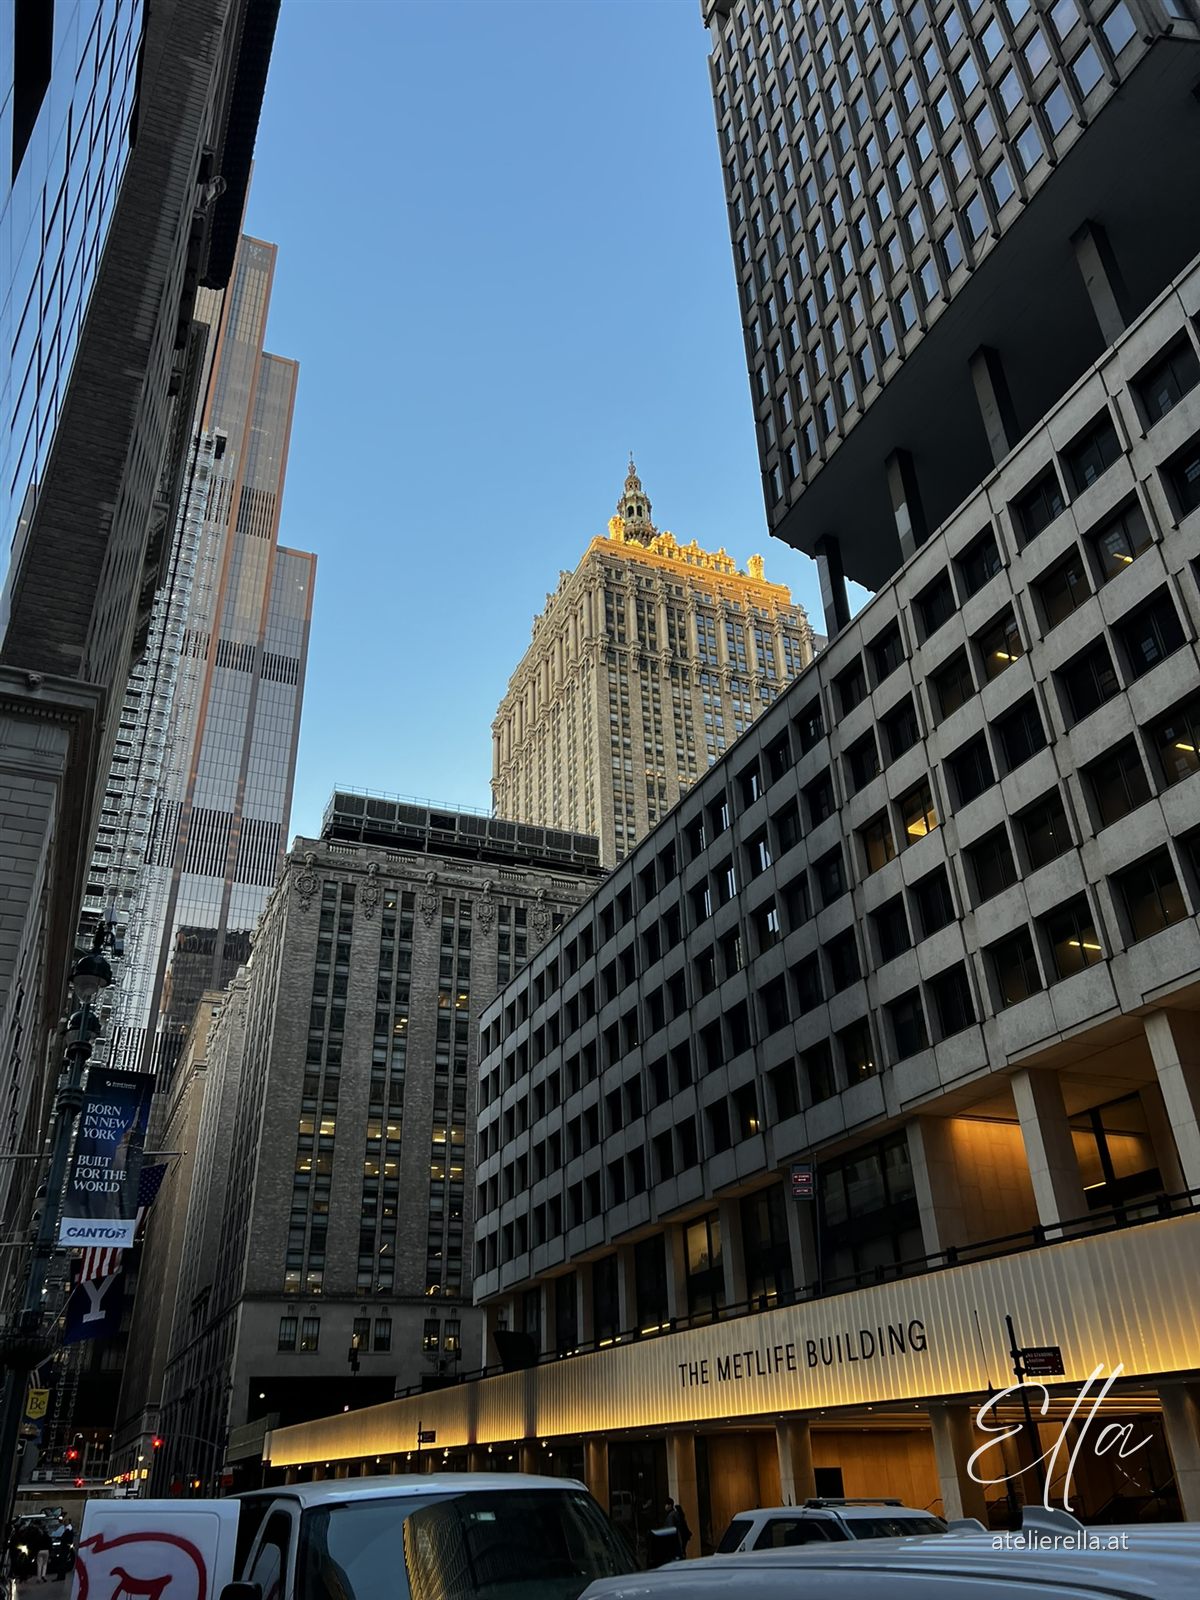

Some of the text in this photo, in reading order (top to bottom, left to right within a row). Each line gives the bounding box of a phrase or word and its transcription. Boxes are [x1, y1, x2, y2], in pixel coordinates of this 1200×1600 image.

[87, 1103, 122, 1116] BORN
[84, 1116, 129, 1129] IN NEW
[83, 1128, 116, 1141] YORK
[77, 1155, 112, 1168] BUILT
[74, 1168, 127, 1181] FOR THE
[73, 1180, 120, 1193] WORLD
[66, 1227, 127, 1239] CANTOR
[678, 1319, 928, 1388] THE METLIFE BUILDING
